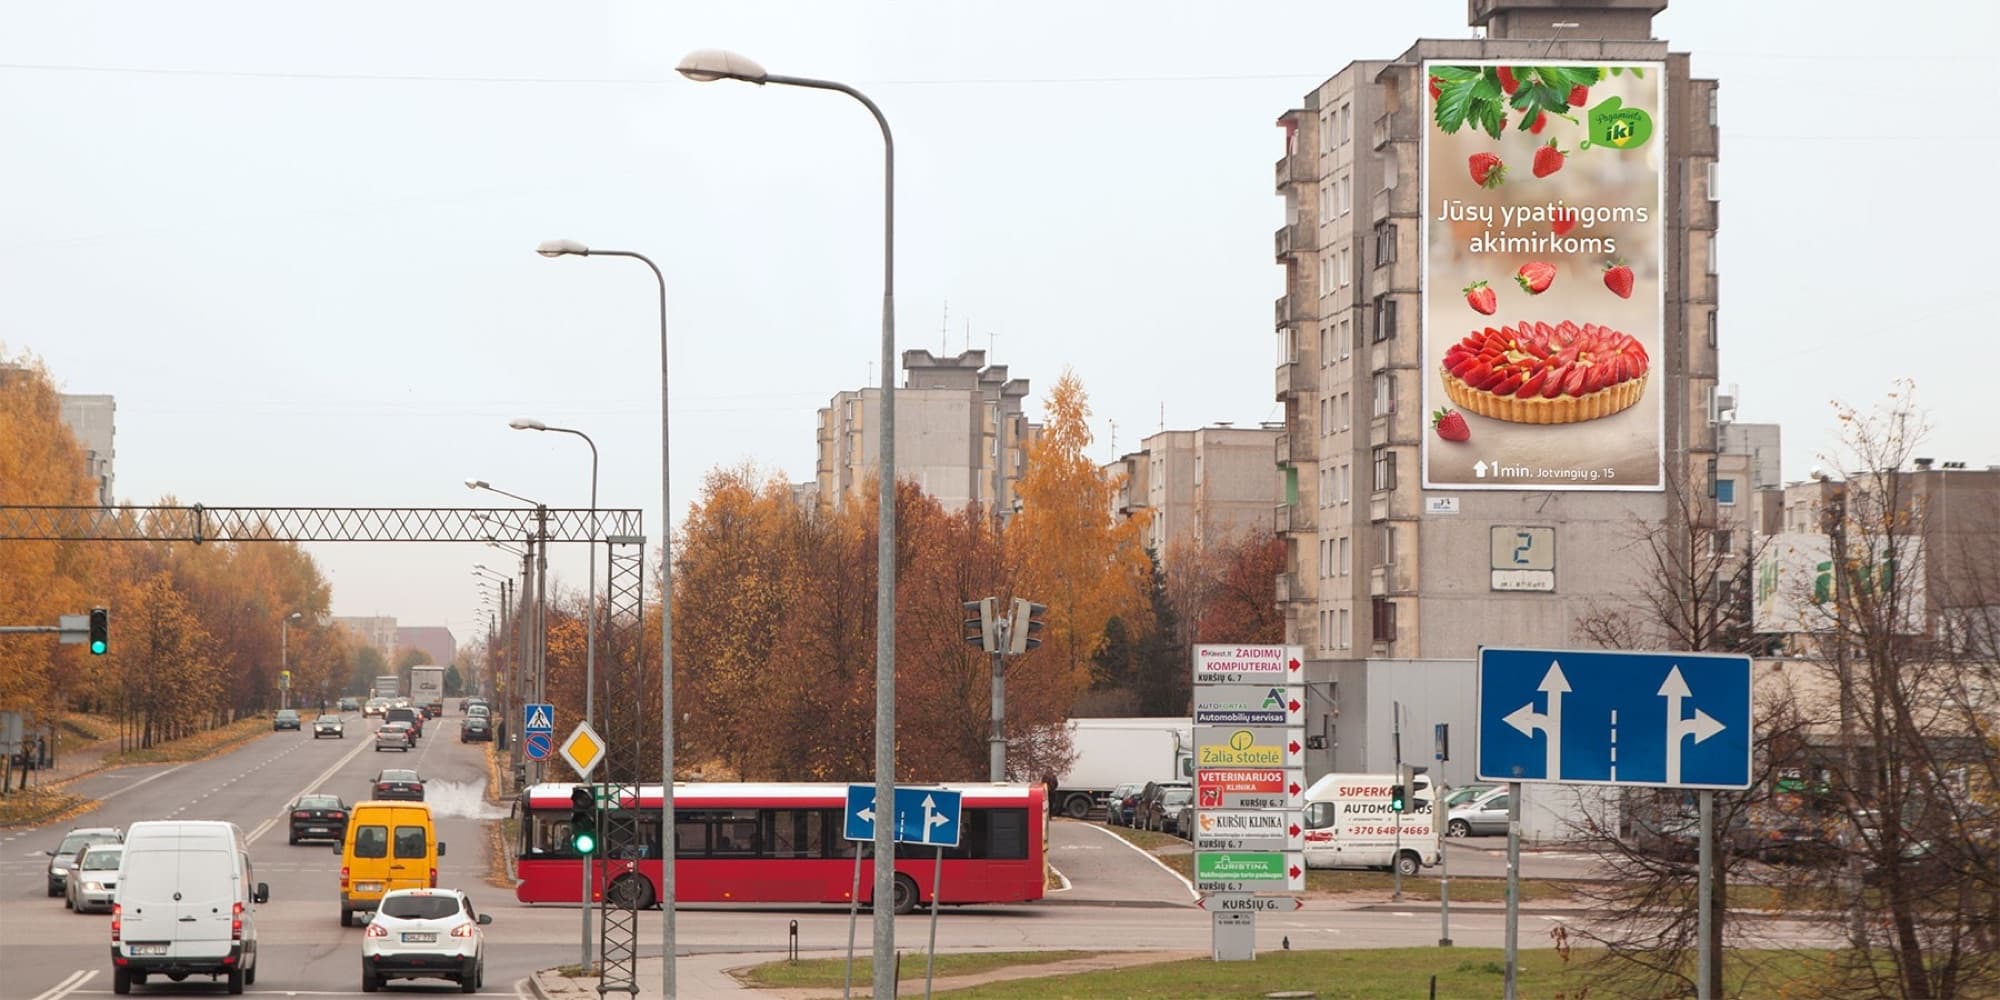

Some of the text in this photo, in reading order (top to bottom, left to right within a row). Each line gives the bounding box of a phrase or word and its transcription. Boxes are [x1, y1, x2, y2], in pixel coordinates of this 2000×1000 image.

[1606, 121, 1634, 141] iki
[1437, 200, 1649, 227] Jūsų ypatingoms
[1469, 231, 1616, 253] akimirkoms
[1537, 468, 1587, 480] Jotvingių
[1590, 470, 1600, 480] g.
[1603, 468, 1615, 478] 15
[1513, 533, 1532, 563] 2
[1236, 648, 1281, 659] ŽAIDIMŲ
[1207, 662, 1281, 671] KOMPIUTERIAI
[1199, 673, 1225, 682] KURŠIŲ
[1200, 713, 1283, 723] Automobilių servisas
[1203, 748, 1279, 763] Žalia stotelė
[1201, 772, 1281, 782] VETERINARIJOS
[1240, 799, 1267, 808] KURŠIŲ
[1217, 815, 1281, 829] KURŠIŲ KLINIKA
[1348, 826, 1374, 835] +370
[1199, 840, 1226, 849] KURŠIŲ
[1199, 882, 1225, 891] KURŠIŲ
[1222, 899, 1279, 911] KURŠIŲ G.
